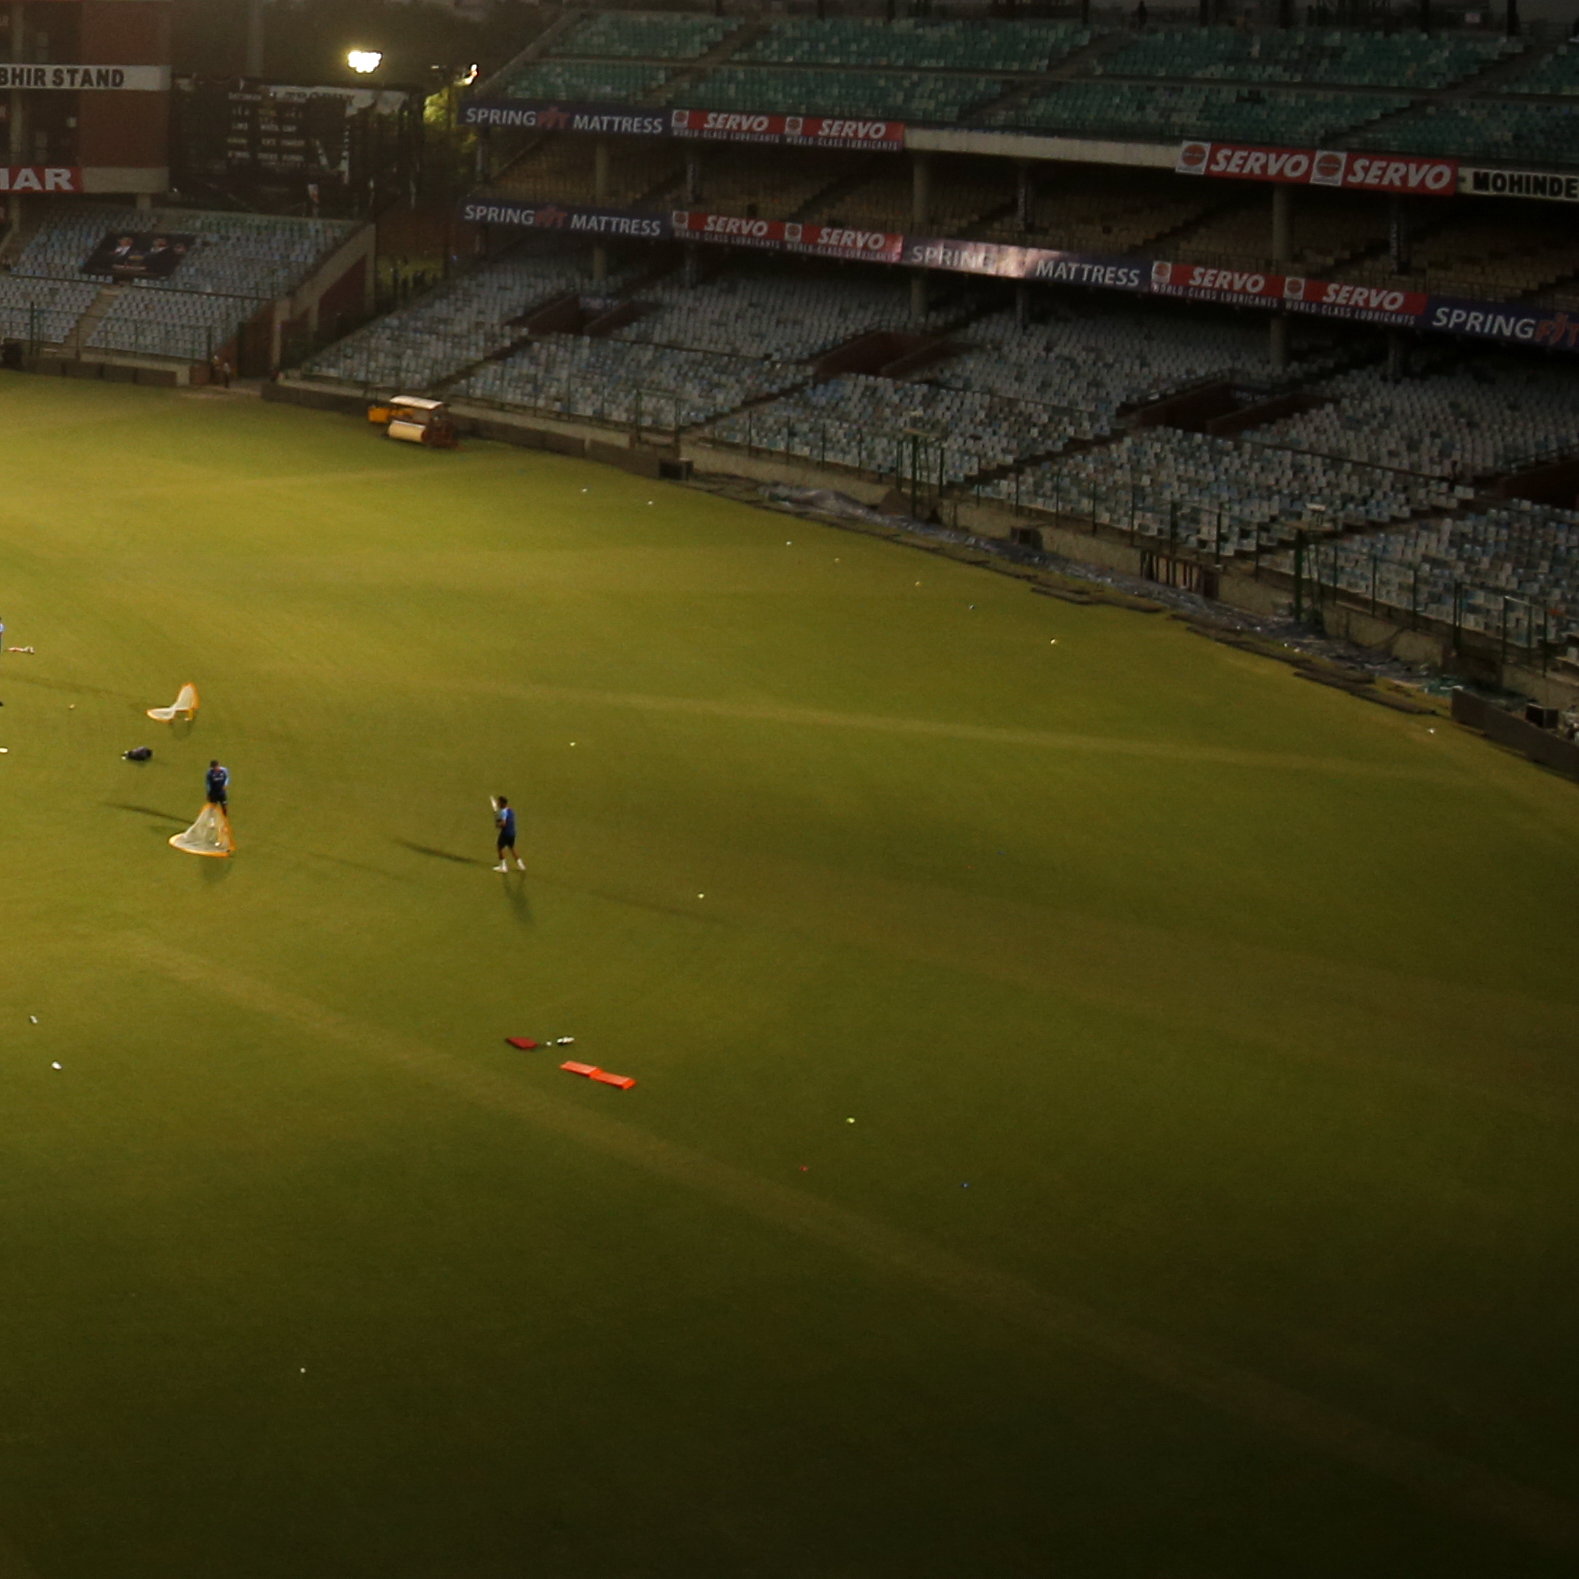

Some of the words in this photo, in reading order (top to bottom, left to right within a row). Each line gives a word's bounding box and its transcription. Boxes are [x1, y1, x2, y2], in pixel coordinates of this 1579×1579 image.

[52, 68, 124, 88] STAND
[573, 114, 663, 134] MATTRESS
[703, 112, 770, 132] SERVO
[818, 119, 886, 139] SERVO
[1210, 148, 1310, 178] SERVO
[1346, 158, 1453, 190] SERVO
[570, 214, 662, 237] MATTRESS
[704, 215, 769, 238] SERVO
[817, 227, 886, 251] SERVO
[1035, 260, 1140, 287] MATTRESS
[1188, 267, 1265, 294] SERVO
[1322, 283, 1404, 311] SERVO
